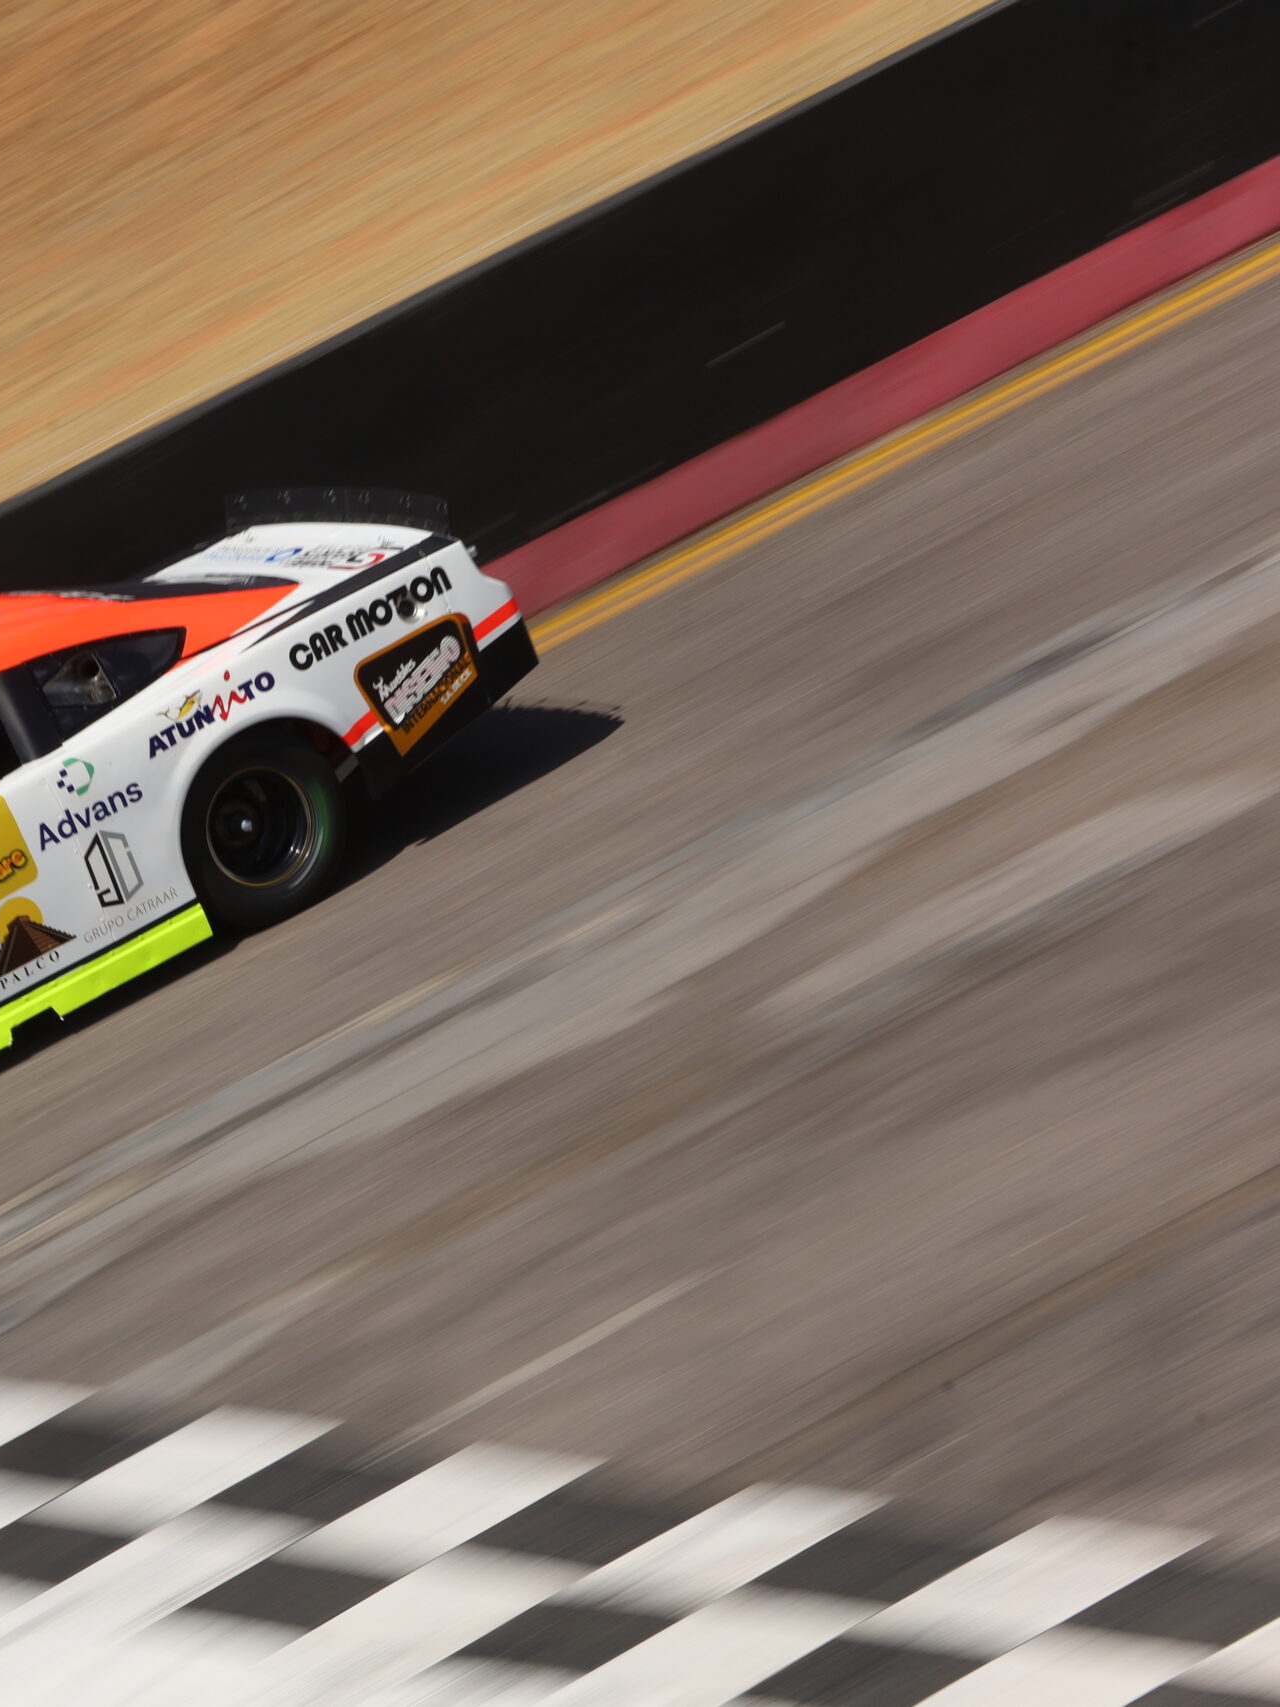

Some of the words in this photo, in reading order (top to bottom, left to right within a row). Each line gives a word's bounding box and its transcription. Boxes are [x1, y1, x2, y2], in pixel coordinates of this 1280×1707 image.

[288, 624, 350, 672] CAR
[38, 781, 144, 852] Advans
[83, 914, 125, 945] GRUPO
[126, 886, 179, 922] CATRAAR
[0, 949, 61, 990] PALCO
